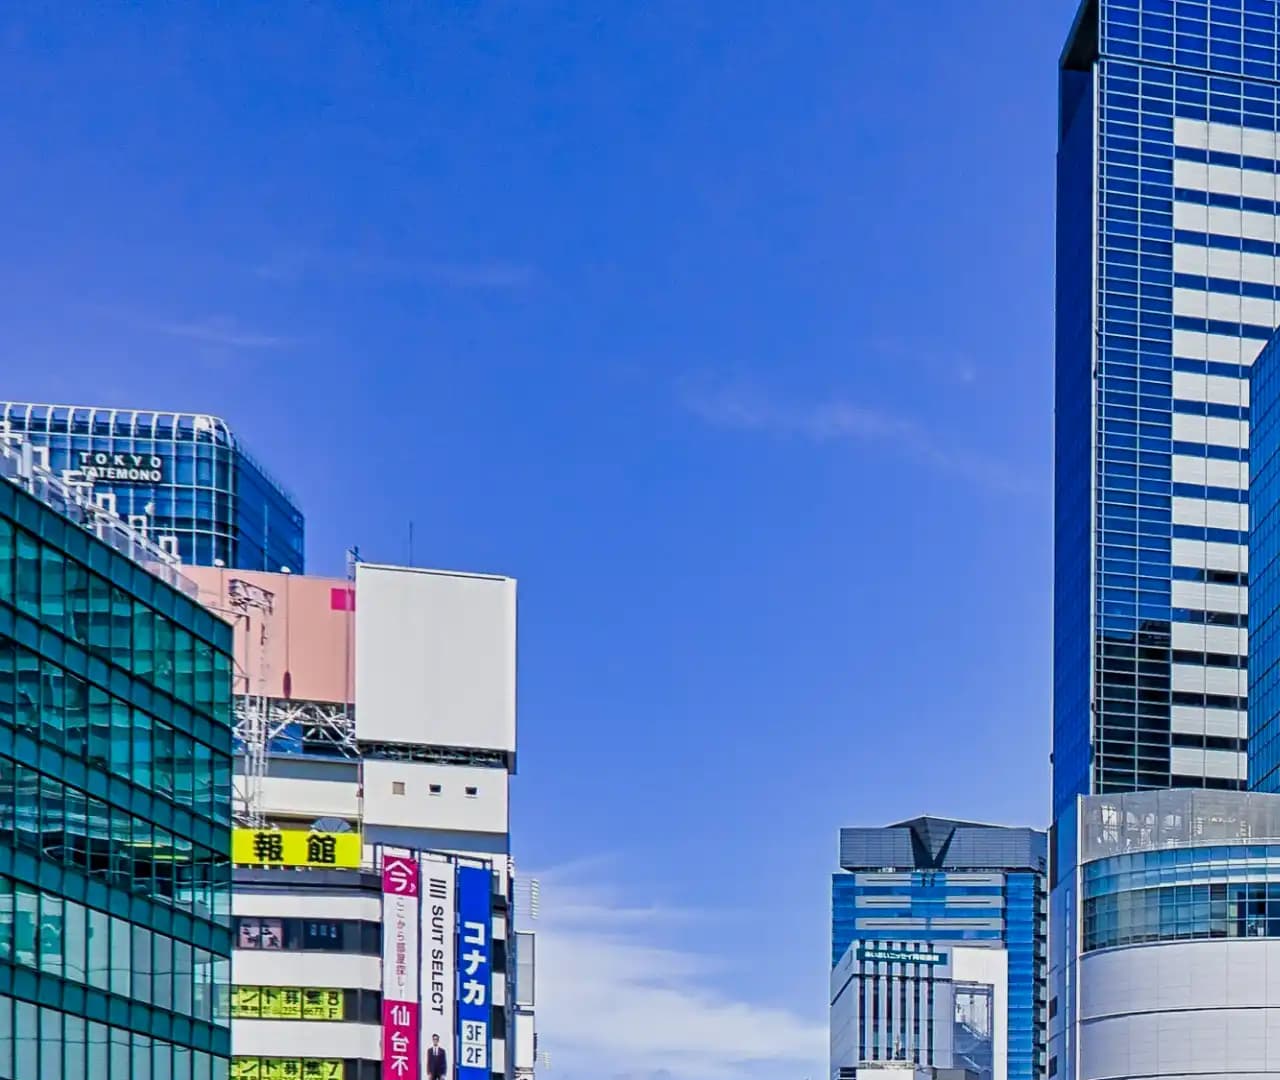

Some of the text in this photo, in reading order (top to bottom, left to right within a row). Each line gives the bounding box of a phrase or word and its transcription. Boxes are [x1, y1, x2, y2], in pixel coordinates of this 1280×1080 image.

[80, 452, 161, 468] TOKYO
[80, 466, 161, 482] TATEMONO
[254, 832, 336, 863] 報館
[431, 905, 444, 1015] SUIT SELECT
[462, 921, 486, 1006] コナカ
[466, 1024, 482, 1042] 3F
[466, 1047, 481, 1064] 2F
